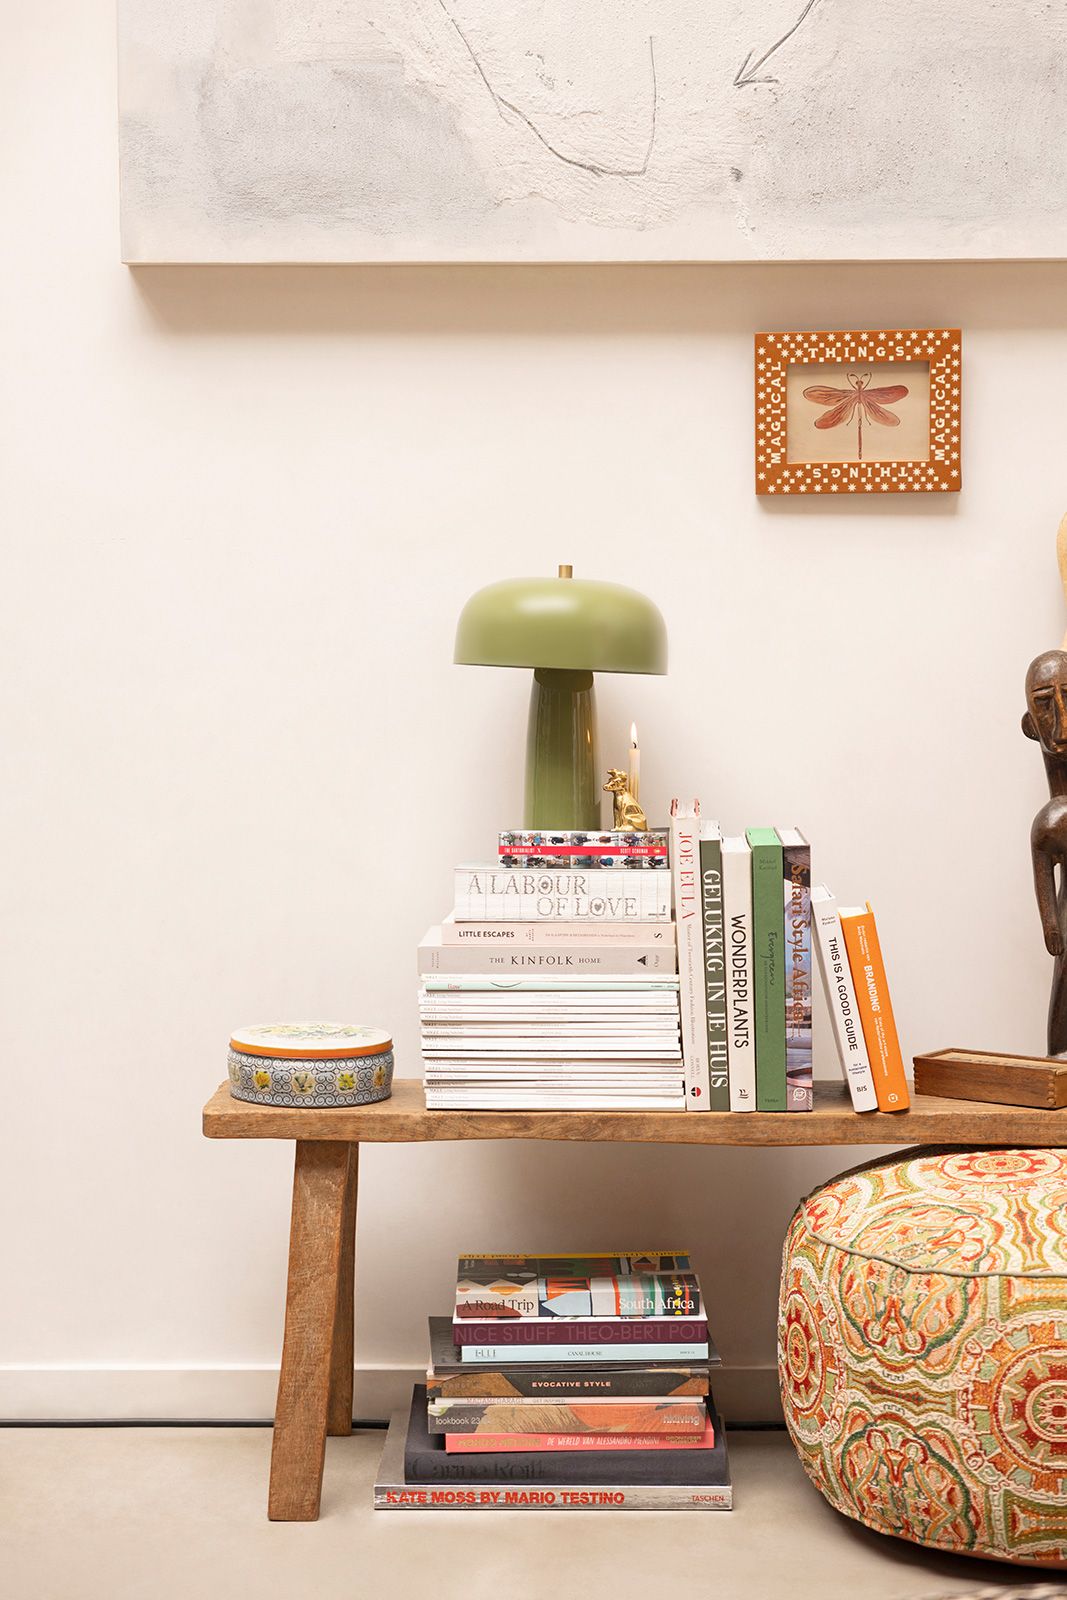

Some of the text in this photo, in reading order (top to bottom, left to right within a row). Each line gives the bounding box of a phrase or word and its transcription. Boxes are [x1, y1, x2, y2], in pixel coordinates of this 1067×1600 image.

[808, 346, 905, 358] THINGS
[770, 361, 782, 464] MAGICAL
[934, 358, 946, 461] MAGICAL
[812, 466, 908, 478] THINGS
[467, 874, 589, 896] A LABOUR
[678, 832, 696, 920] JOE EULA
[791, 864, 809, 915] Safari
[537, 897, 638, 917] OF LOVE
[787, 919, 809, 963] Style
[828, 937, 841, 961] THIS
[511, 956, 574, 966] KINFOLK
[760, 931, 778, 986] Evergreen
[833, 962, 843, 974] IS
[703, 869, 728, 1088] GELUKKIG IN JE HUIS
[731, 914, 750, 1049] WONDERPLANTS
[835, 975, 845, 984] A
[864, 965, 881, 1012] BRANDING
[791, 968, 810, 1021] Africa
[838, 985, 852, 1017] GOOD
[844, 1018, 858, 1051] GUIDE
[462, 1298, 534, 1313] A Road Trip
[618, 1297, 695, 1310] South Africa
[454, 1323, 705, 1343] NICE STUFF THEO-BERT POT
[435, 1417, 469, 1425] lookbook
[547, 1437, 554, 1446] DE
[557, 1437, 580, 1446] WERELD
[582, 1436, 594, 1445] VAN
[596, 1436, 633, 1445] ALESSANDRO
[386, 1491, 625, 1505] KATE MOSS BY MARIO TESTINO
